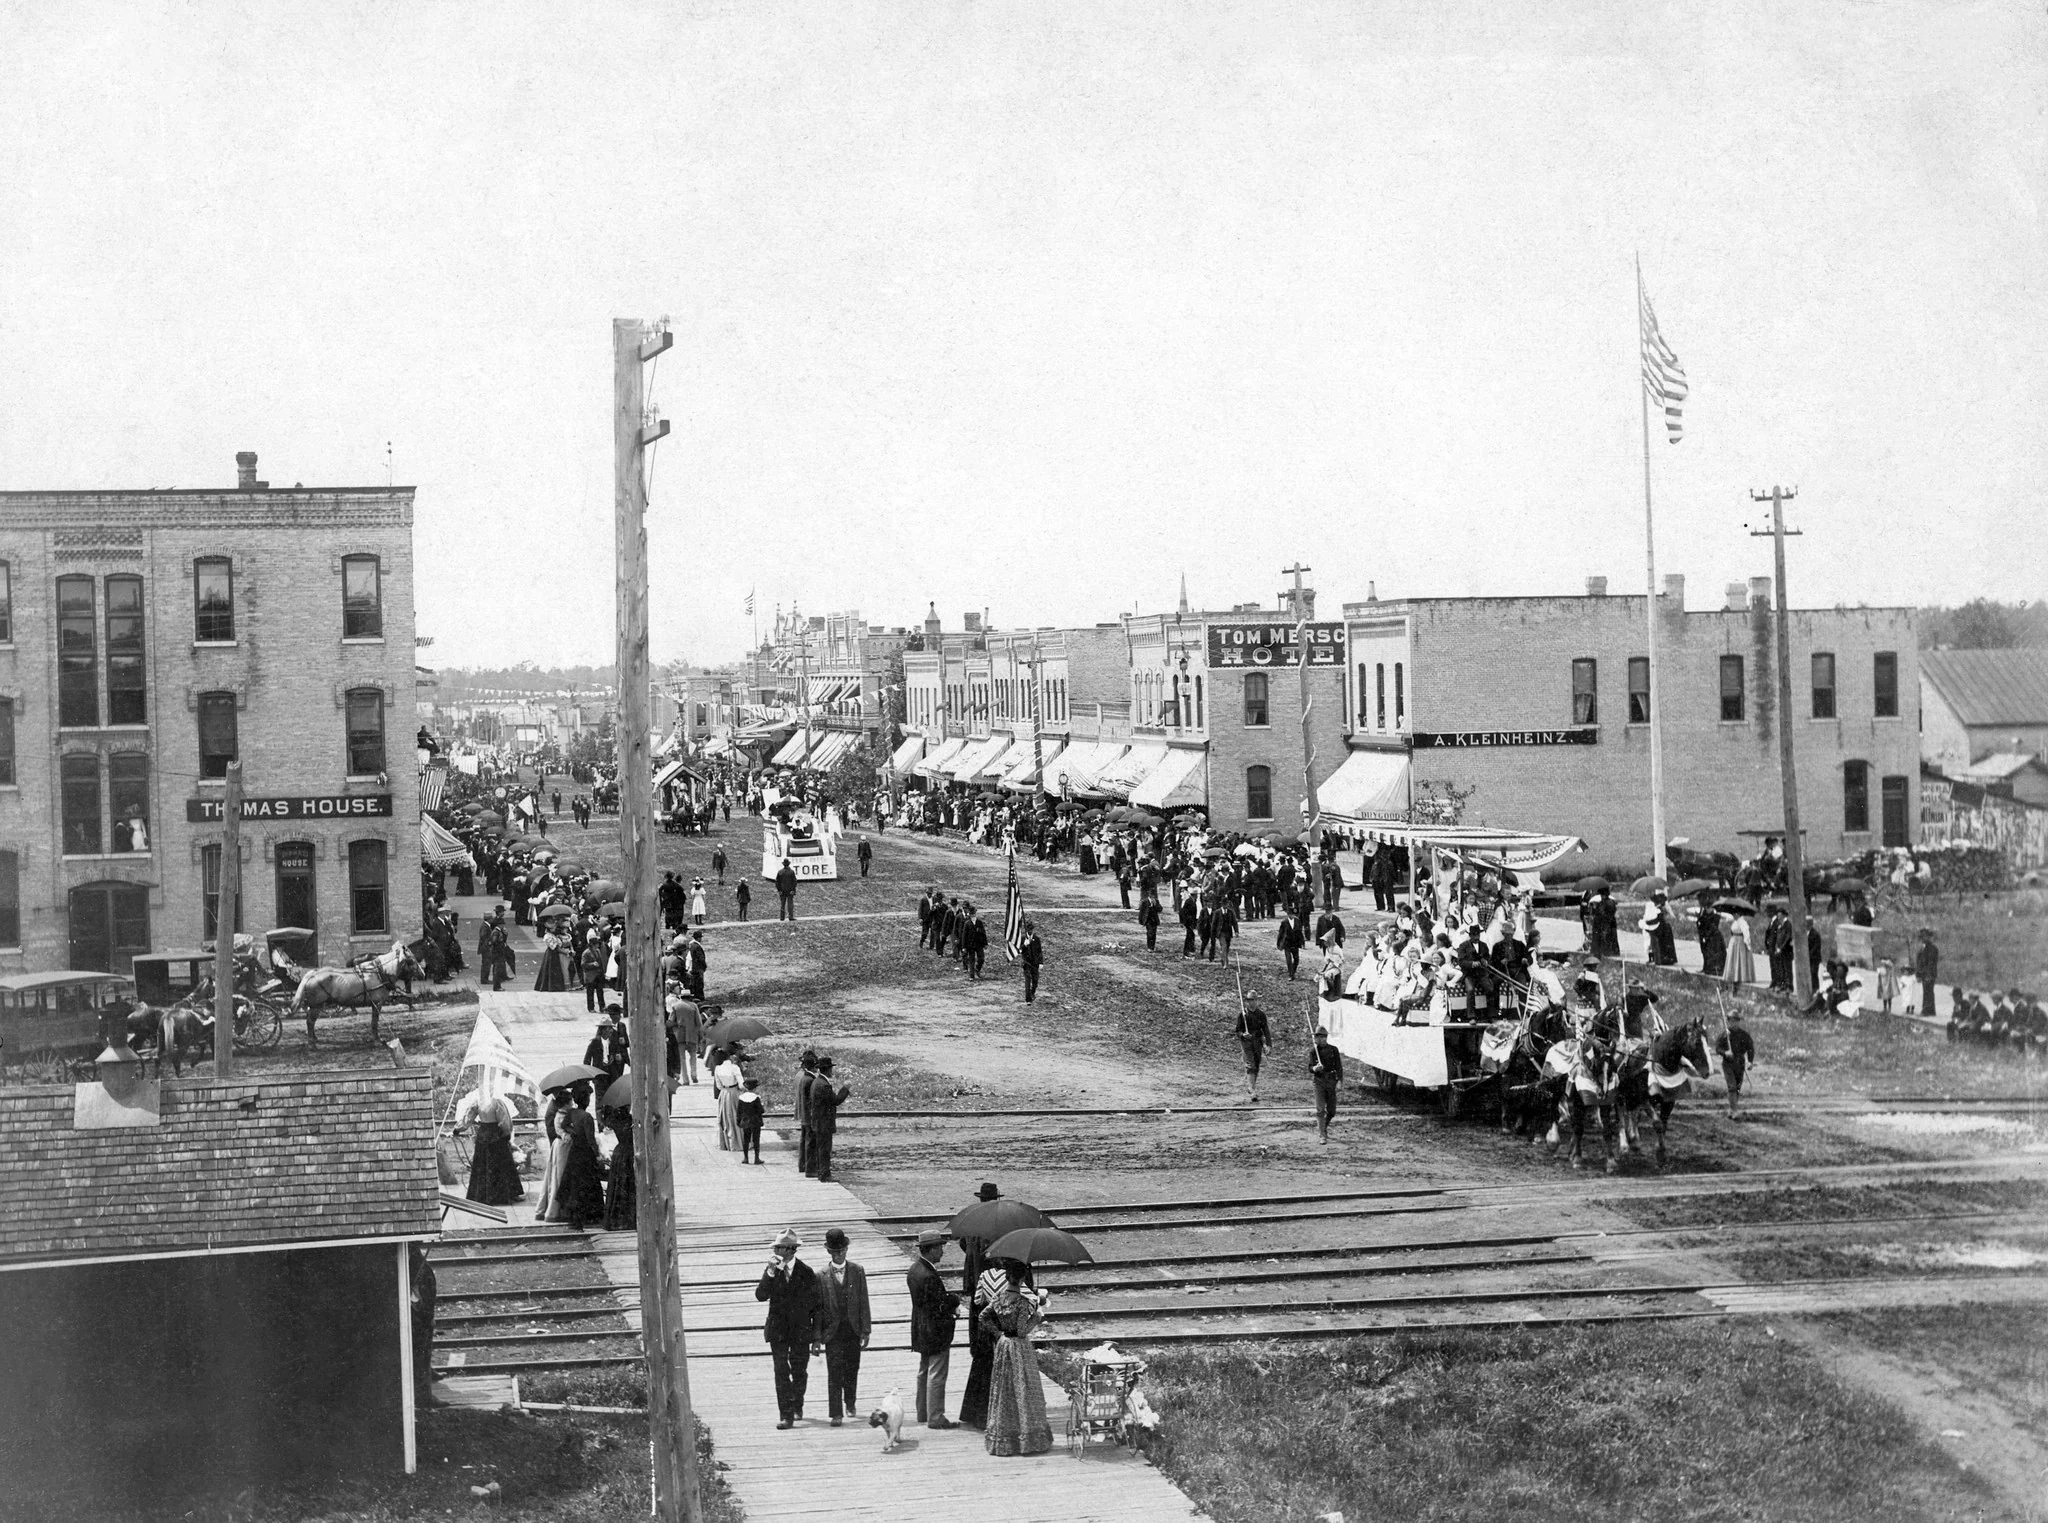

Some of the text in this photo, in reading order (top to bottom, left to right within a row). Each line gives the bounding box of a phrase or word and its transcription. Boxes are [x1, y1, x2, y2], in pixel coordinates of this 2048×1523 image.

[1216, 628, 1260, 644] TOM
[1221, 646, 1346, 664] HOTE
[1434, 732, 1574, 747] A. KLEINHEINZ.
[201, 798, 383, 817] THMAS HOUSE.
[282, 859, 308, 867] HOUSE
[792, 864, 833, 876] TORE.
